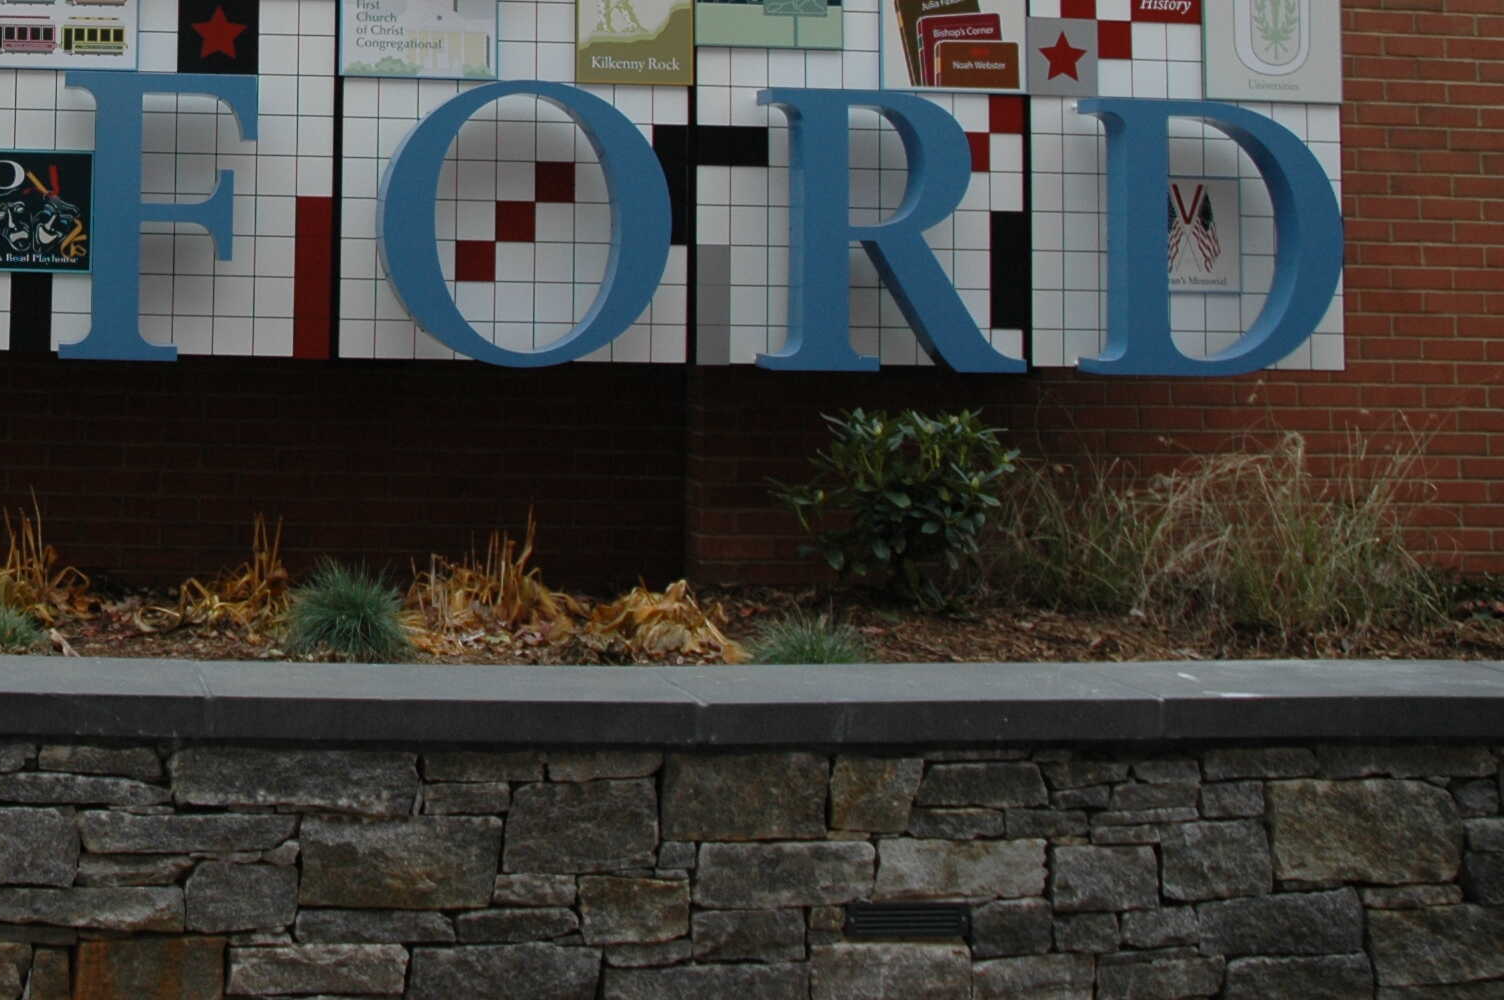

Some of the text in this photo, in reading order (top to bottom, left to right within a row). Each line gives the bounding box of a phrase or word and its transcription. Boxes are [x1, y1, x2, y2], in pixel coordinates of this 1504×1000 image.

[355, 11, 398, 23] Church
[355, 25, 405, 36] of Christ
[932, 26, 995, 40] Bishop's Corner
[355, 37, 443, 52] Congregational
[591, 55, 681, 73] Kilkenny Rock
[952, 60, 974, 70] Noah
